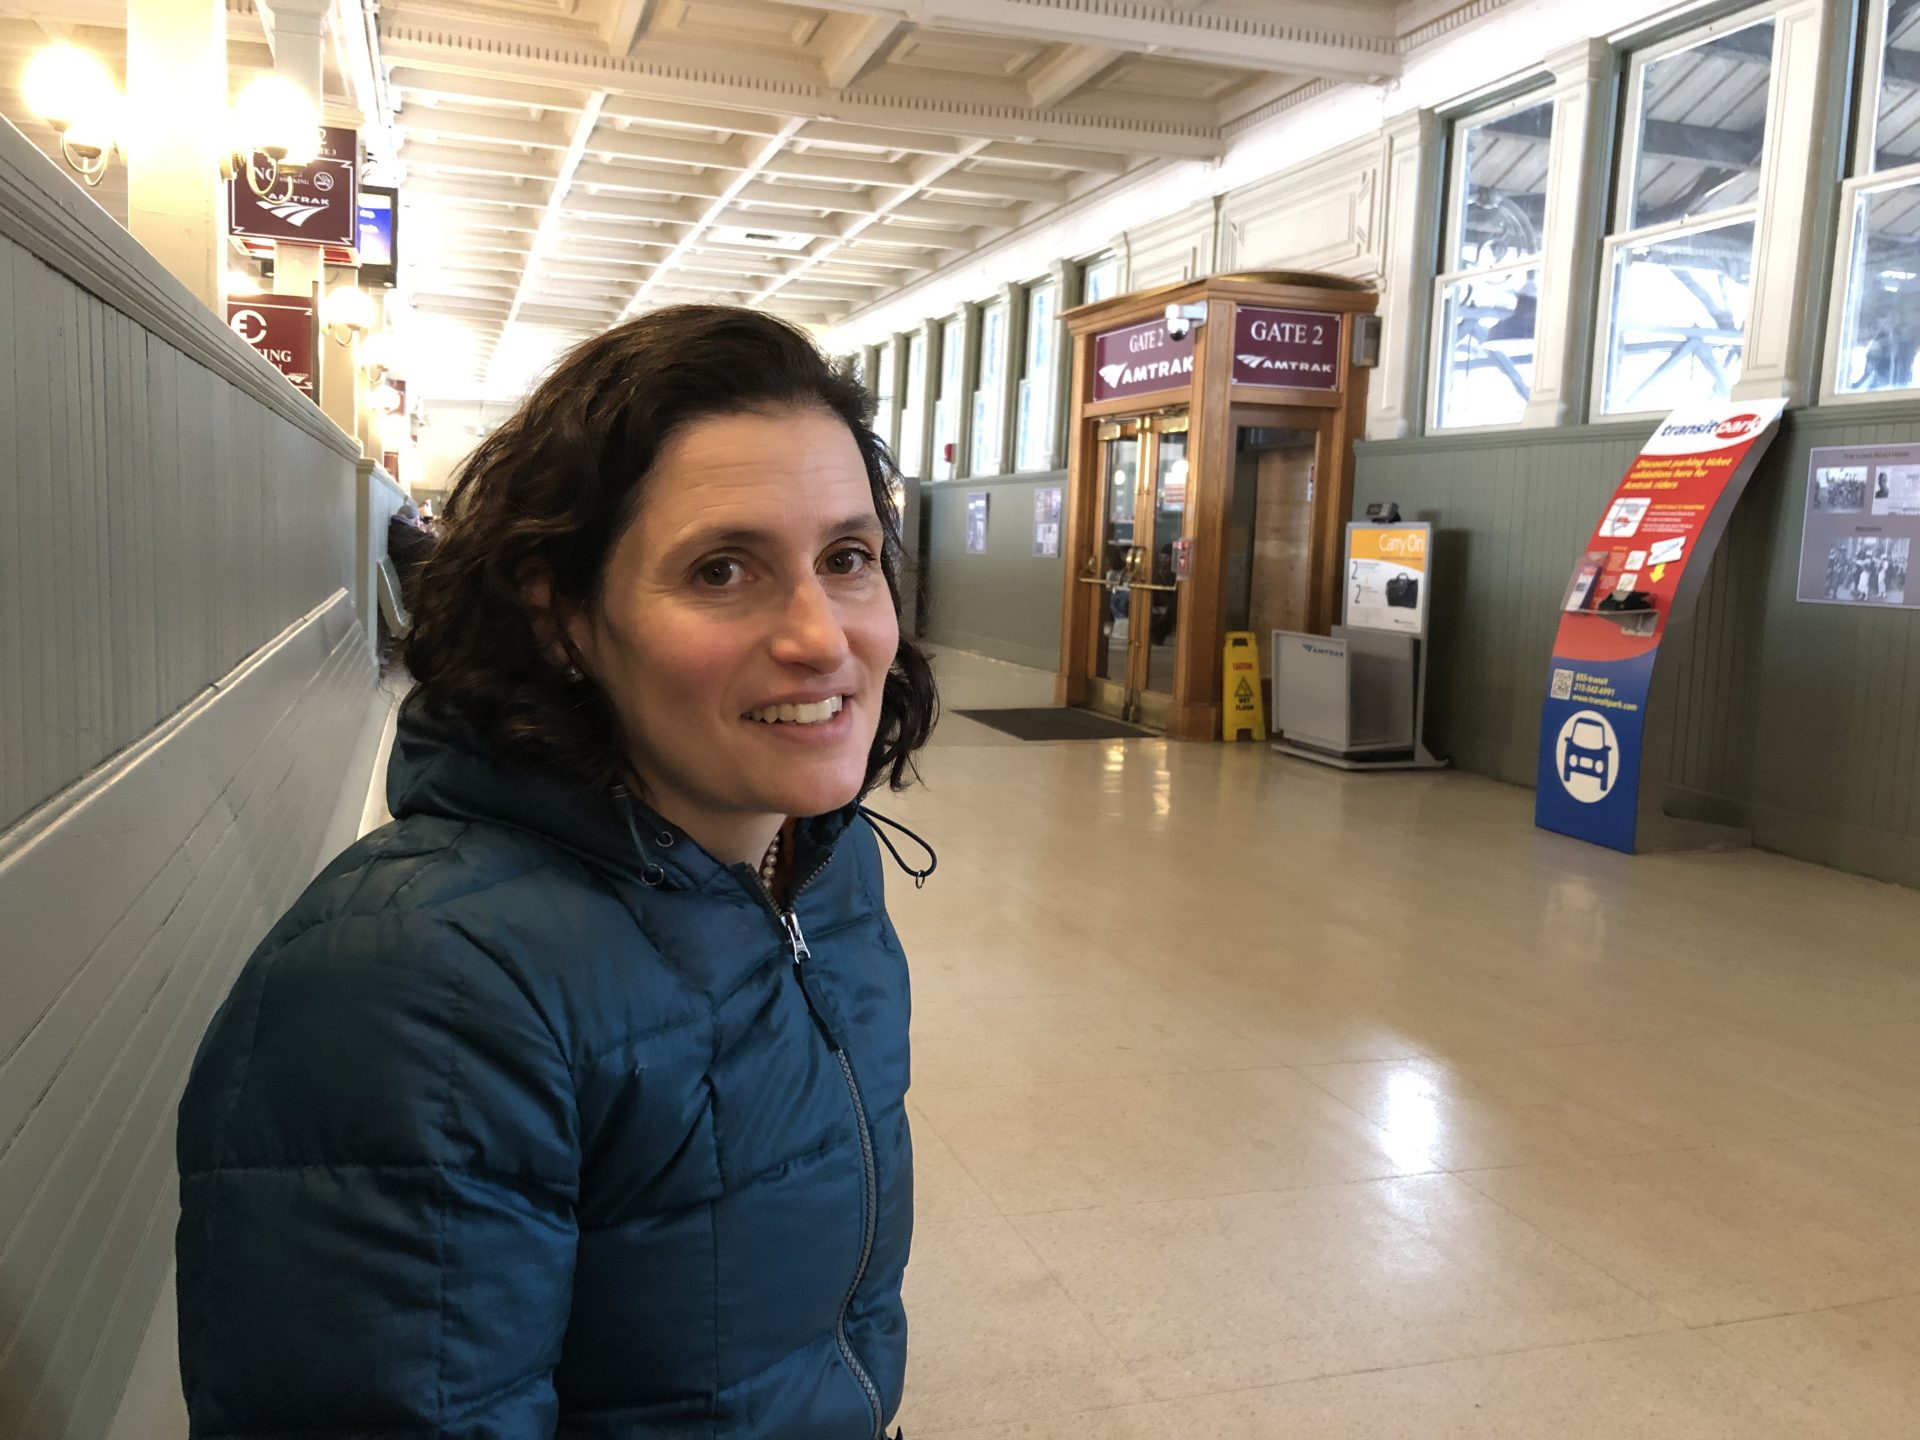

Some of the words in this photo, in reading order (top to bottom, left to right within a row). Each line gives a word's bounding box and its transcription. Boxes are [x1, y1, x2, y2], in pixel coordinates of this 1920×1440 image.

[280, 176, 309, 185] SMKING
[268, 192, 330, 205] AMTRAK
[1129, 331, 1156, 353] GATE
[1158, 328, 1165, 347] 2
[1250, 320, 1307, 344] GATE
[1312, 325, 1324, 345] 2
[1122, 355, 1194, 385] AMTRAK
[1262, 359, 1332, 373] AMTRAK
[1705, 456, 1733, 467] ticket
[1672, 468, 1694, 478] here
[1693, 469, 1709, 478] for
[1378, 533, 1406, 556] Carry
[1407, 534, 1425, 552] On
[1351, 561, 1358, 580] 2
[1354, 584, 1361, 604] 2
[1313, 648, 1345, 658] AMTRAK
